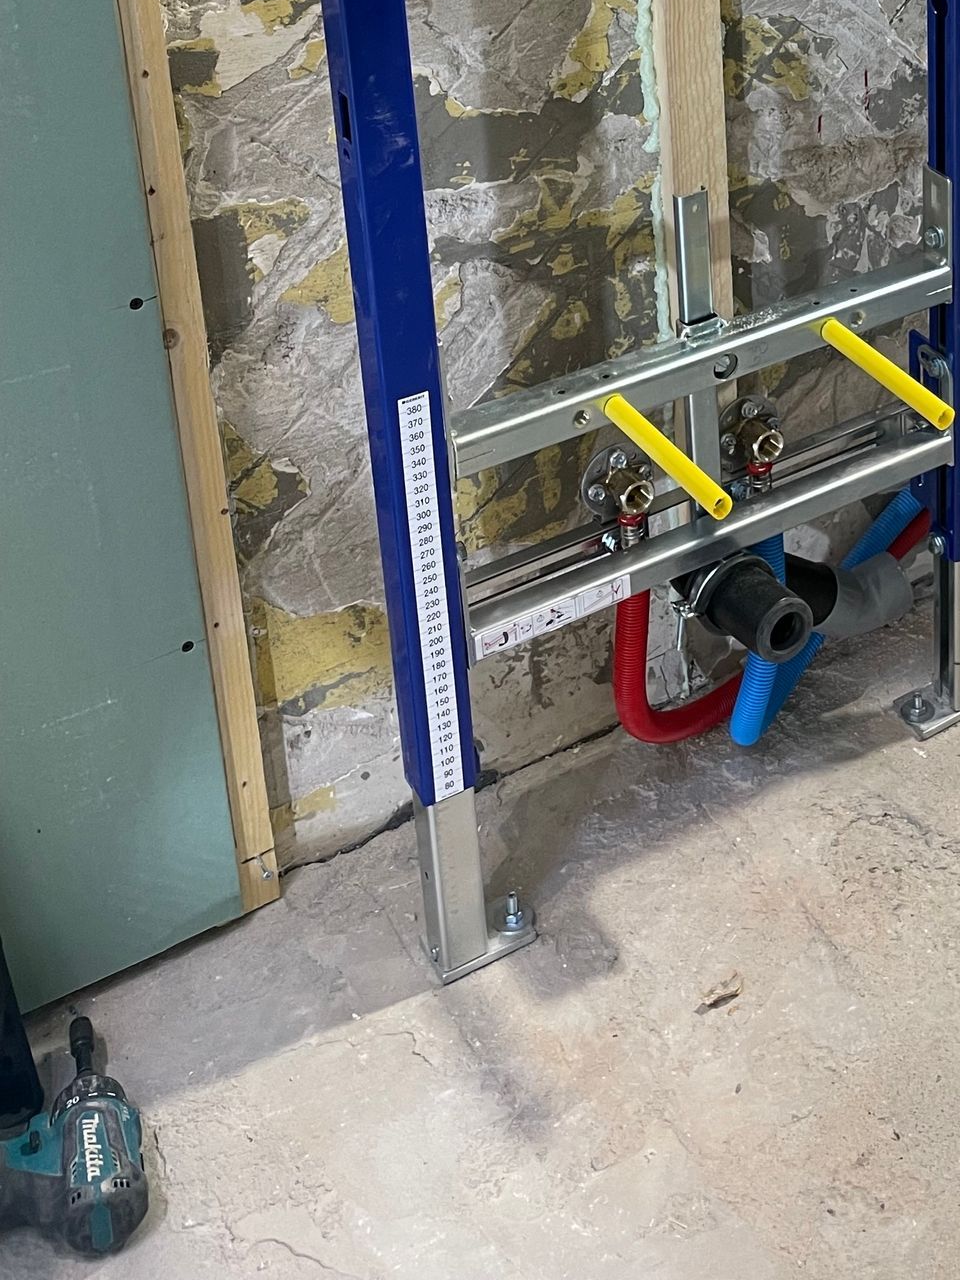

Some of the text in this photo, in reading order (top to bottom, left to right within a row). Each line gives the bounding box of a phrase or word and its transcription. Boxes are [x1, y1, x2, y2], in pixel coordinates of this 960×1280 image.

[407, 404, 422, 415] 380
[408, 418, 422, 428] 370
[409, 431, 424, 442] 360
[410, 444, 425, 455] 350
[412, 457, 426, 468] 340
[413, 471, 427, 481] 330
[414, 484, 428, 495] 320
[415, 497, 430, 508] 310
[416, 510, 431, 520] 300
[418, 522, 432, 534] 290
[419, 535, 433, 546] 280
[420, 548, 434, 559] 270
[422, 561, 436, 572] 260
[423, 573, 437, 584] 250
[424, 586, 438, 597] 240
[426, 598, 440, 610] 230
[426, 611, 440, 622] 220
[428, 623, 442, 634] 210
[429, 636, 443, 647] 200
[431, 648, 444, 658] 190
[432, 660, 445, 670] 180
[433, 672, 447, 683] 170
[435, 684, 448, 695] 160
[436, 697, 449, 707] 150
[437, 708, 450, 719] 140
[438, 720, 451, 731] 130
[439, 732, 452, 743] 120
[440, 744, 453, 755] 110
[441, 756, 454, 766] 100
[444, 769, 453, 778] 90
[445, 780, 454, 790] 80
[65, 1095, 80, 1109] 20
[81, 1112, 104, 1182] makita
